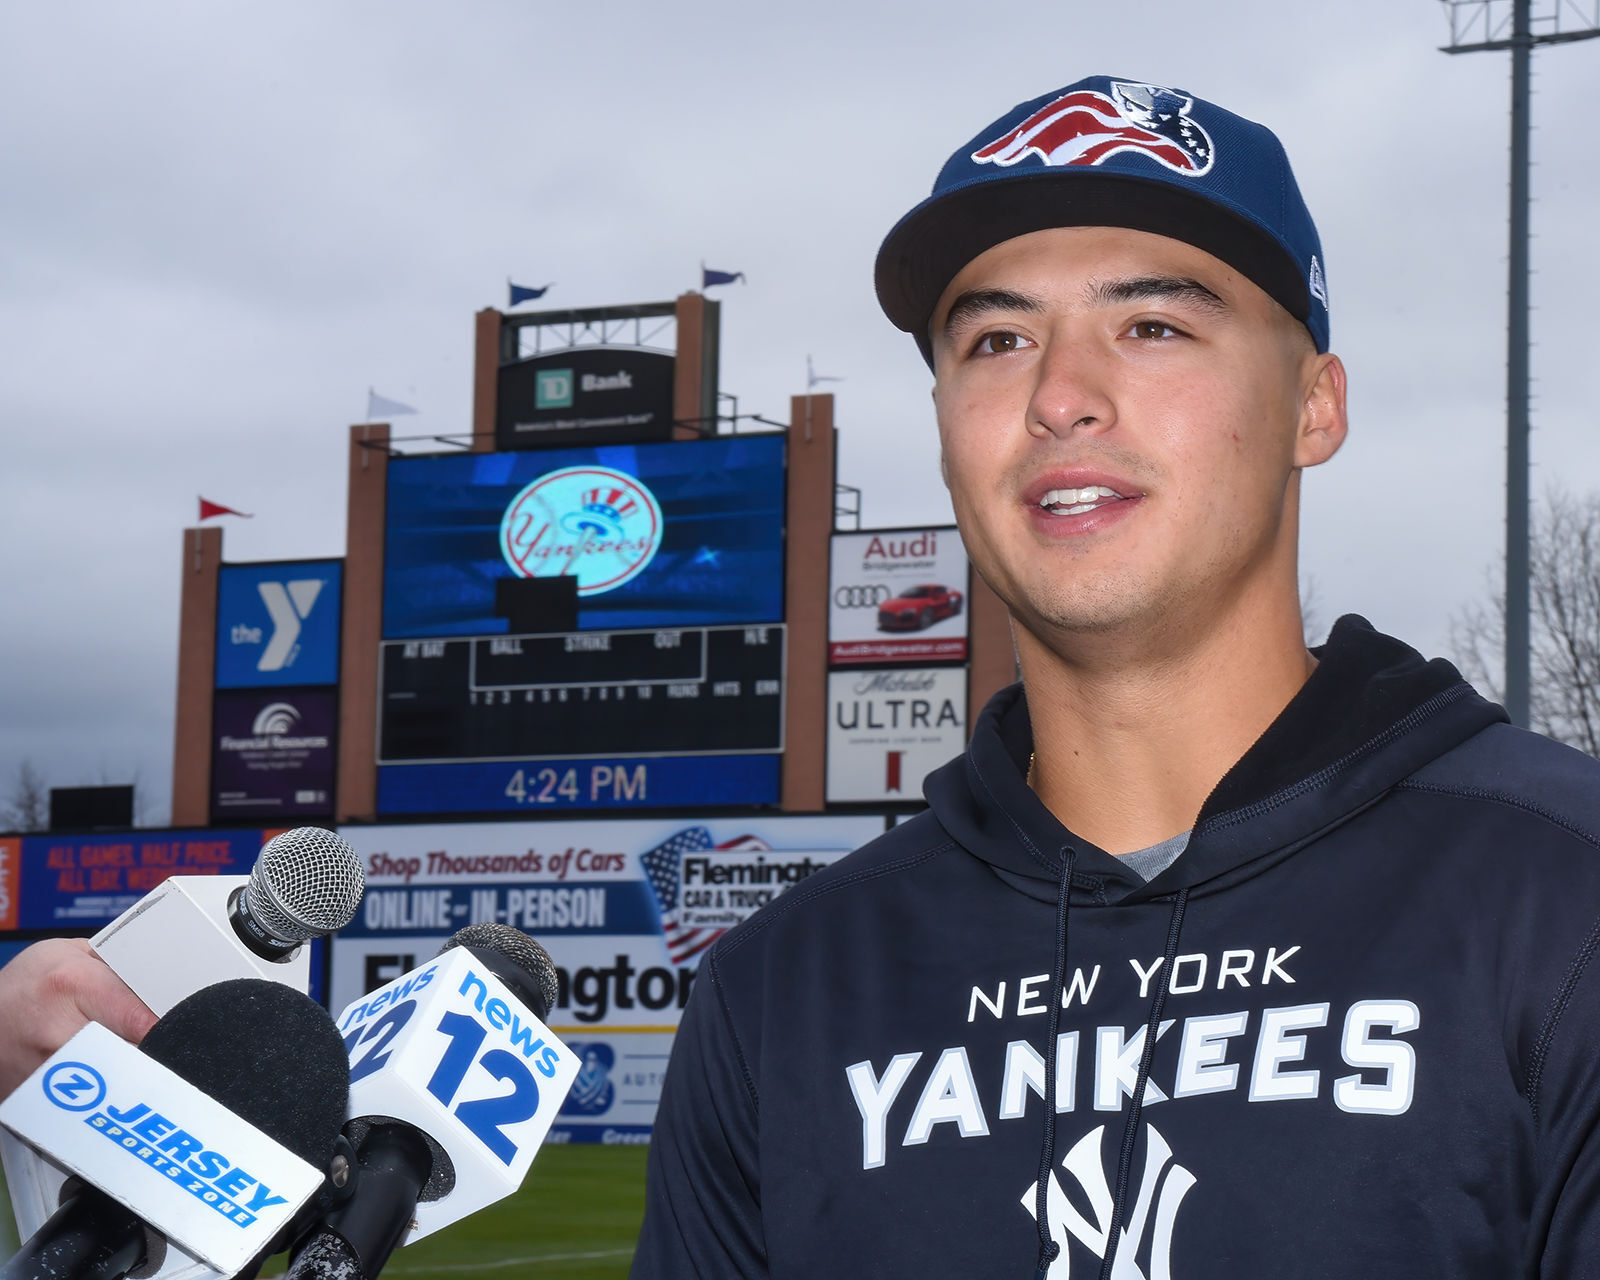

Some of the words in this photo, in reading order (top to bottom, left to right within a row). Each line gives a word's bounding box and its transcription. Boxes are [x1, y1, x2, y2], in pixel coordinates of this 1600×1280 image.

[541, 376, 570, 401] TD
[581, 371, 633, 392] Bank
[511, 513, 647, 567] Yankees
[864, 532, 937, 559] Audi
[231, 623, 263, 645] the
[490, 637, 523, 655] BALL
[564, 633, 611, 652] STRIKE
[654, 630, 682, 648] OUT
[836, 699, 959, 729] ULTRA
[504, 768, 580, 804] 4:24
[590, 765, 648, 802] PM
[46, 846, 75, 869] ALL
[142, 842, 181, 865] HALF
[367, 853, 422, 883] Shop
[426, 849, 542, 876] Thousands
[547, 847, 575, 880] of
[575, 848, 626, 873] Cars
[57, 868, 86, 892] ALL
[365, 889, 453, 930] ONLINE
[684, 889, 712, 908] CAR
[341, 964, 440, 1032] news
[967, 964, 1101, 1023] NEW
[1129, 945, 1302, 998] YORK
[458, 970, 560, 1079] news
[426, 1010, 540, 1168] 12
[845, 999, 1420, 1170] YANKEES
[91, 1115, 183, 1178] SPORTS
[186, 1179, 249, 1224] ZONE
[106, 1102, 290, 1214] JERSEY
